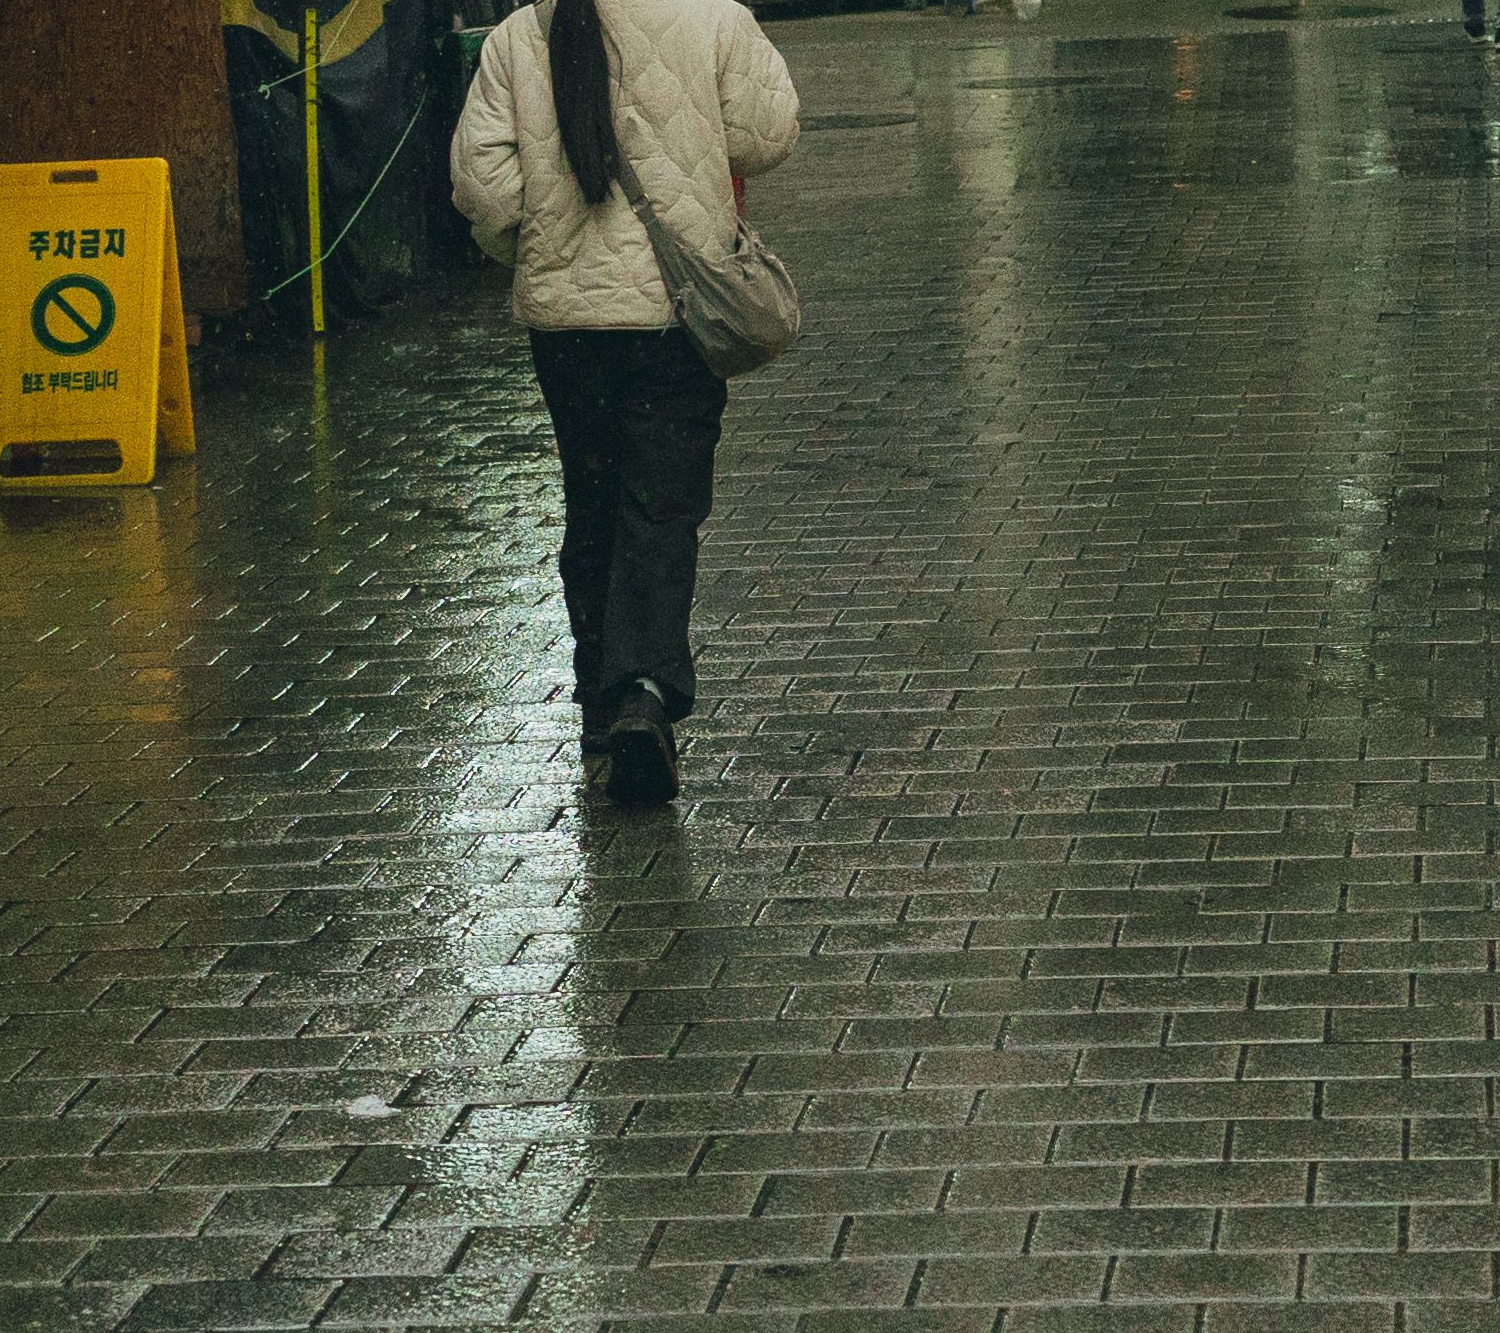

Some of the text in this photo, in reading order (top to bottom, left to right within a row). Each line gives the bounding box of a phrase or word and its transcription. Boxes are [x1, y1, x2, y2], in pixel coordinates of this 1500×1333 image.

[27, 227, 126, 261] 주차금지
[20, 368, 119, 395] 협조 부탁드립니다
